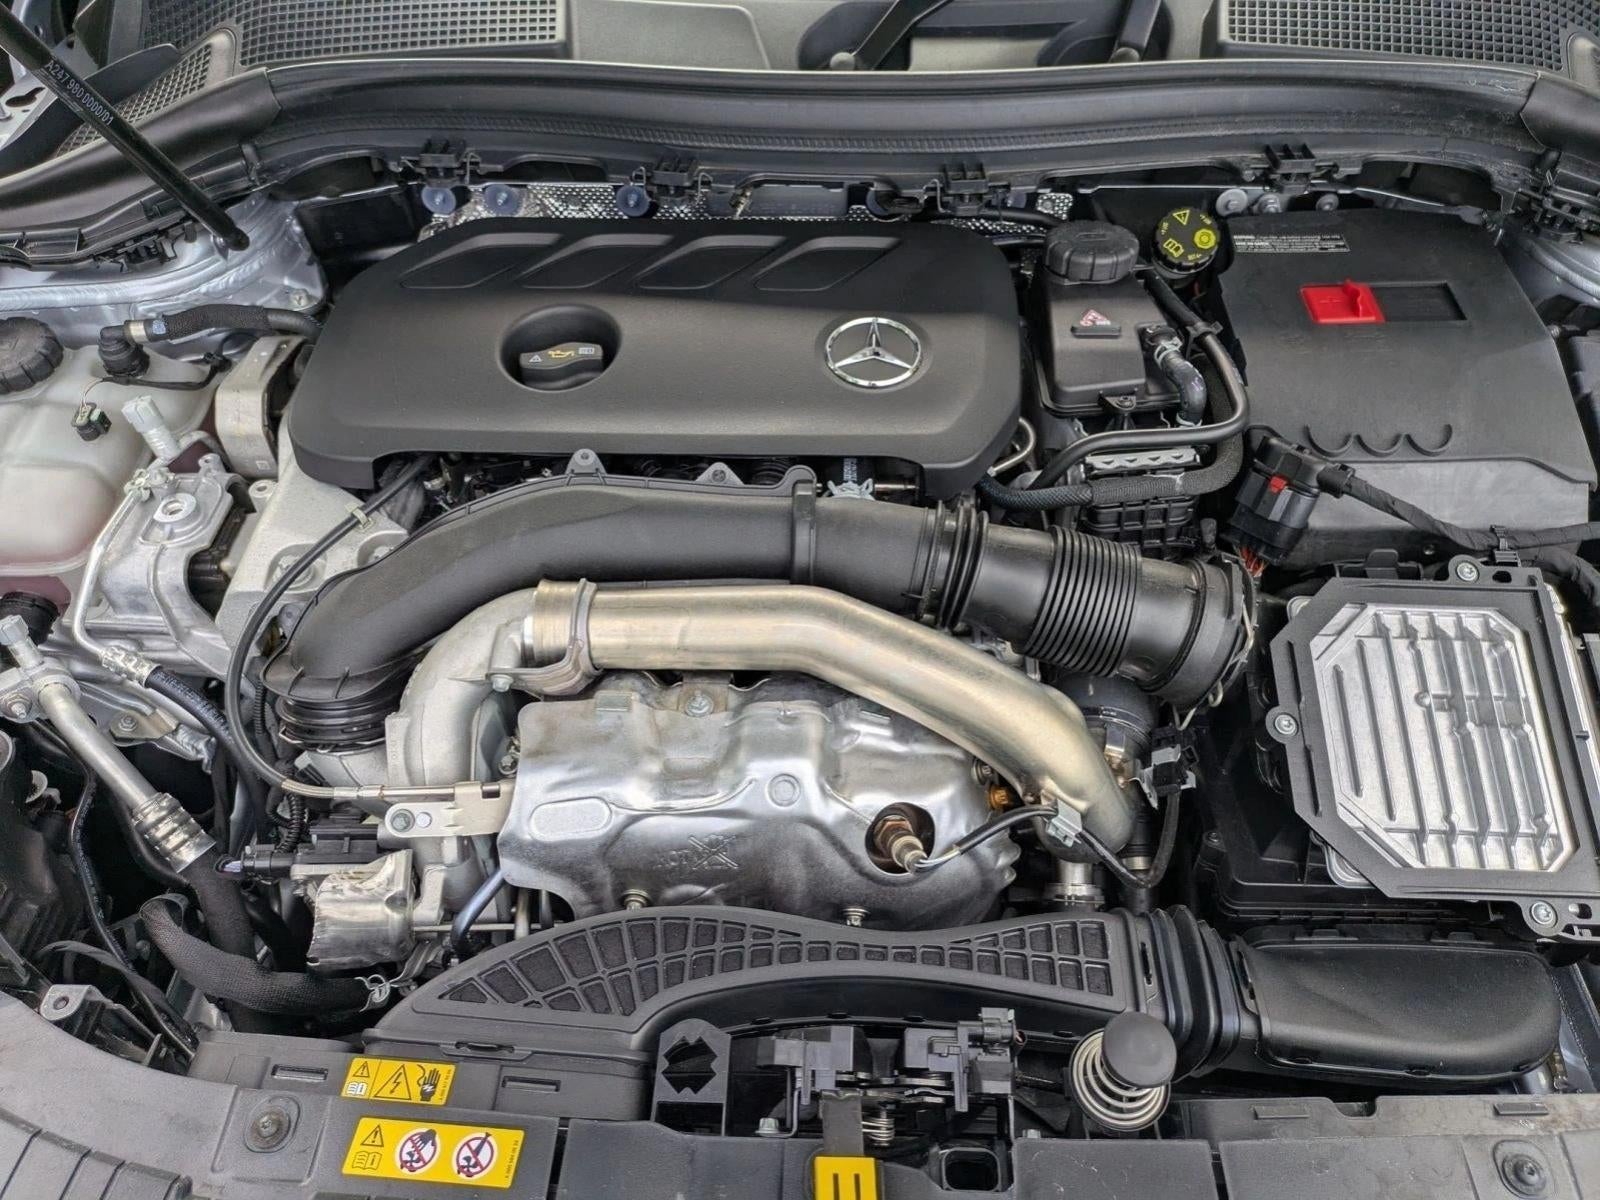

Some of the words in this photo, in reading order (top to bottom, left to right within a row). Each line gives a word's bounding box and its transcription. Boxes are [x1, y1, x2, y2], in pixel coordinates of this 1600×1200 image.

[45, 60, 70, 83] A247
[67, 79, 84, 98] 980
[82, 93, 114, 126] 0000/01
